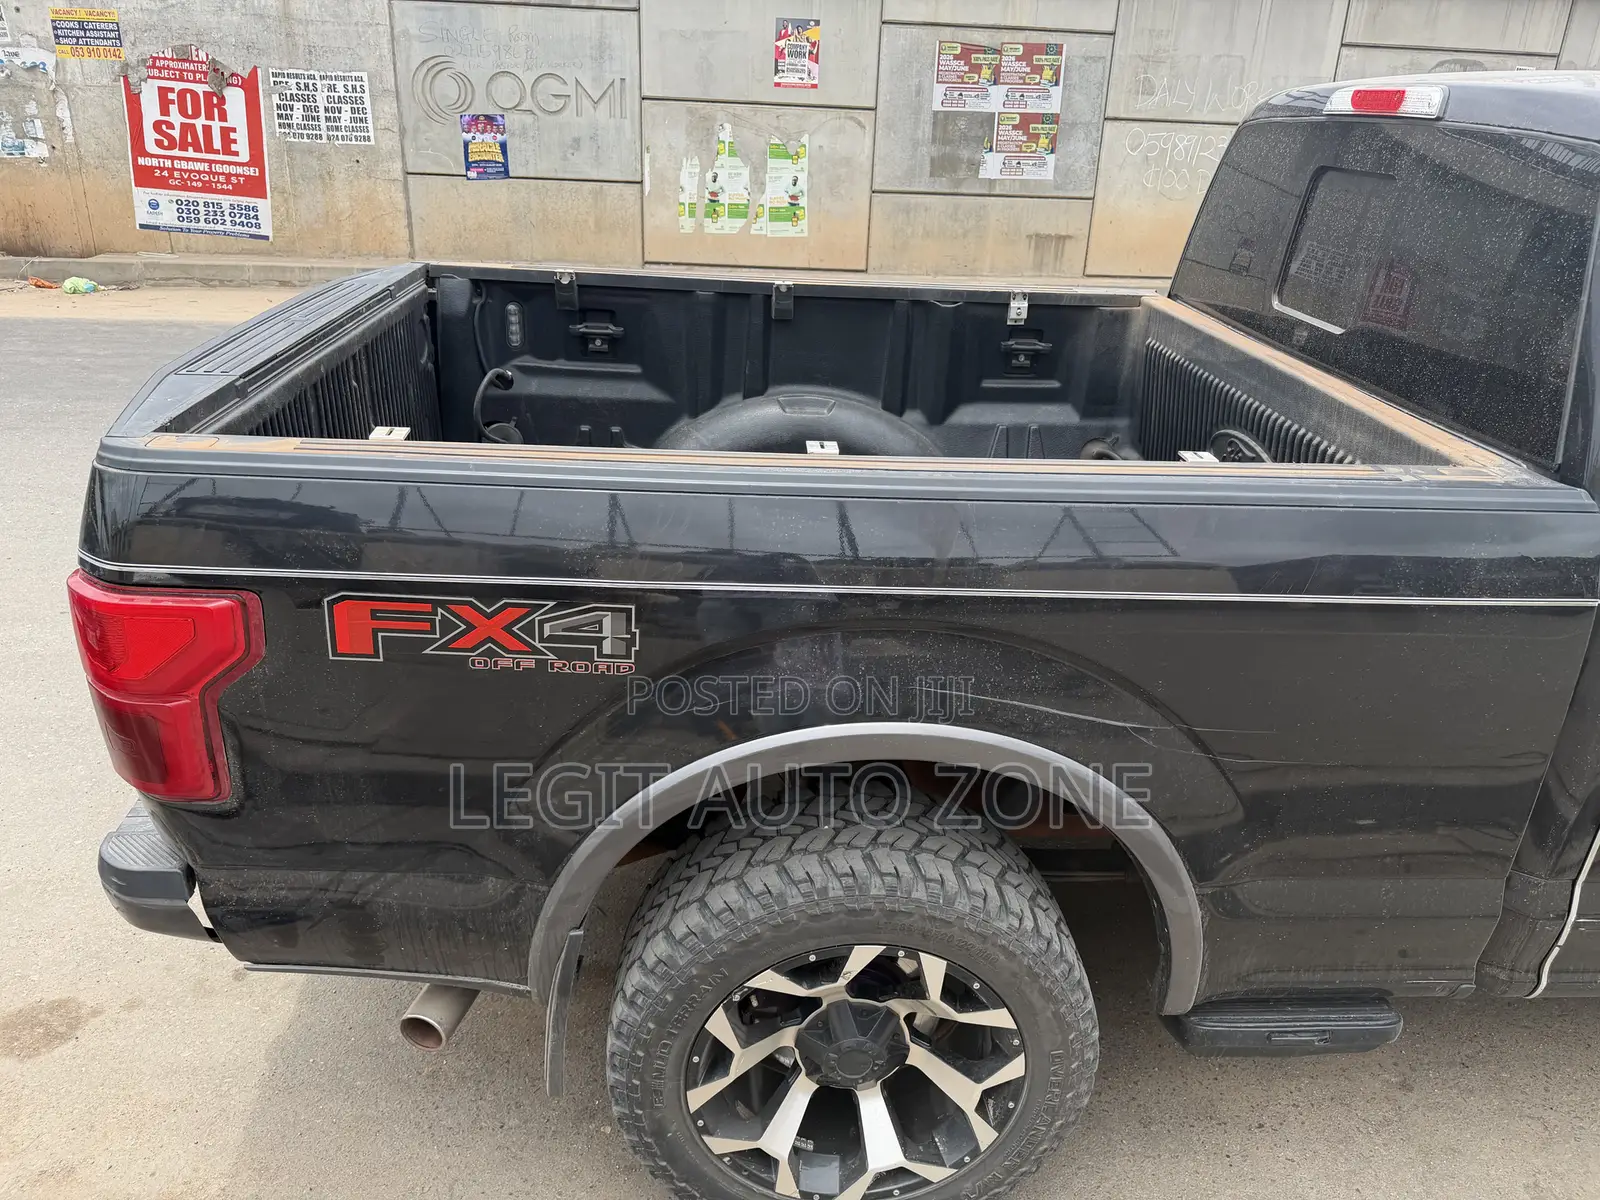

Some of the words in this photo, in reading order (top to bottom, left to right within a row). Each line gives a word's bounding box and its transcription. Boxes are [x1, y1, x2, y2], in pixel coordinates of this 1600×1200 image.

[84, 22, 118, 30] CATERERS
[57, 29, 85, 37] KITCHEN
[86, 30, 119, 38] ASSISTANT
[78, 38, 121, 46] ATTENDANTS
[70, 47, 84, 57] 053
[86, 47, 100, 58] 910
[103, 48, 122, 59] 0142
[787, 50, 807, 59] WORK
[146, 69, 179, 78] UBJECT
[183, 72, 193, 80] TO
[296, 82, 318, 92] S.H.S
[344, 84, 365, 94] S.H.S
[278, 93, 317, 103] CLASSES
[486, 70, 627, 118] QGMI
[157, 86, 228, 122] FOR
[326, 95, 365, 105] CLASSES
[276, 103, 294, 112] NOV
[302, 104, 319, 113] DEC
[324, 106, 342, 114] NOV
[350, 107, 368, 115] DEC
[277, 113, 294, 121] MAY
[302, 114, 321, 123] JUNE
[349, 116, 368, 124] JUNE
[278, 122, 294, 130] HOME
[296, 123, 321, 132] CLASSES
[326, 124, 343, 132] HOME
[344, 125, 369, 134] CLASSES
[152, 120, 239, 157] SALE
[306, 132, 323, 140] 9288
[354, 134, 371, 142] 9288
[138, 156, 172, 168] NORTH
[174, 160, 210, 172] GBAWE
[154, 169, 169, 177] 24
[174, 171, 226, 182] EVOQUE
[231, 176, 245, 184] ST
[175, 199, 199, 208] 020
[203, 201, 223, 210] 815
[228, 203, 259, 213] 5586
[176, 207, 200, 216] 030
[204, 209, 225, 218] 233
[228, 211, 259, 221] 0784
[177, 216, 200, 224] 059
[204, 217, 227, 226] 602
[230, 220, 261, 229] 9408
[324, 592, 639, 662] FX4
[469, 656, 536, 671] OFF
[548, 659, 636, 676] ROAD
